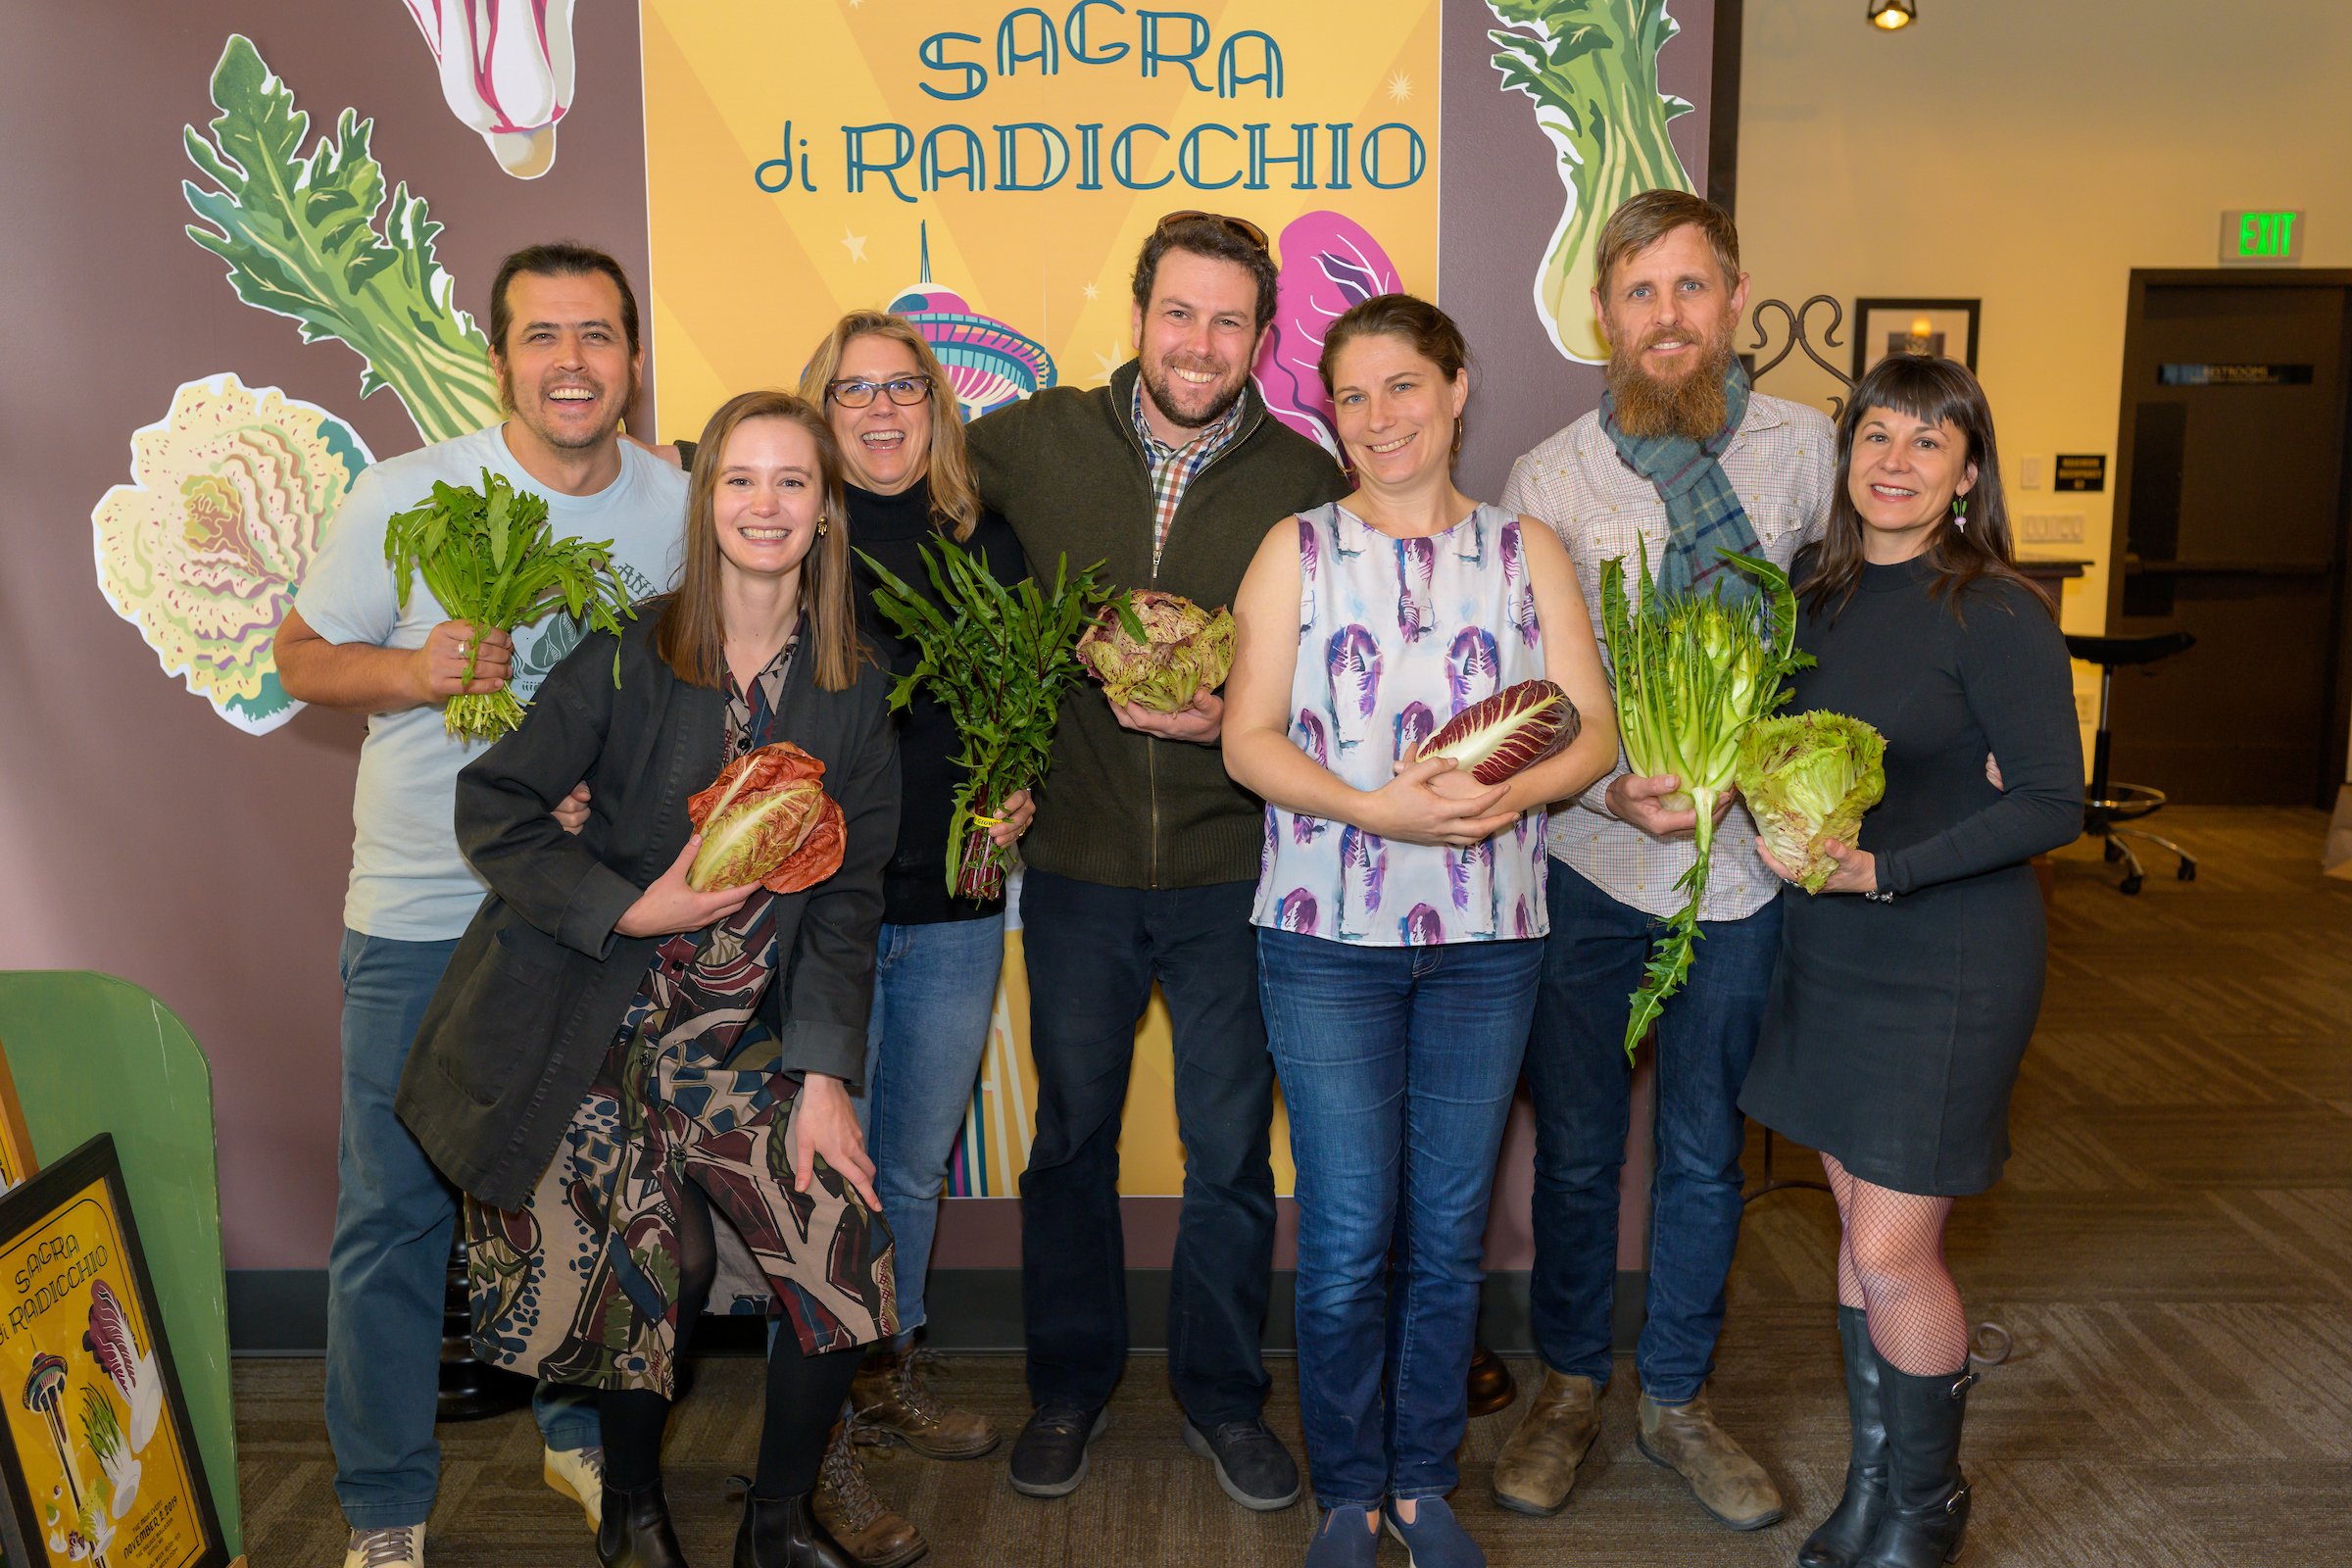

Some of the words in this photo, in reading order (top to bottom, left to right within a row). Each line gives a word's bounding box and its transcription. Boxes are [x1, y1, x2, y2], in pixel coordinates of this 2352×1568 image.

[918, 0, 1284, 101] SAGRA
[754, 120, 817, 194] di
[841, 121, 1427, 204] RADICCHIO
[2239, 213, 2297, 257] EXIT
[8, 1245, 108, 1334] RADICCHIO
[15, 1234, 80, 1294] SAGRA
[123, 1516, 160, 1559] NOVEMBER
[164, 1494, 177, 1516] 2019
